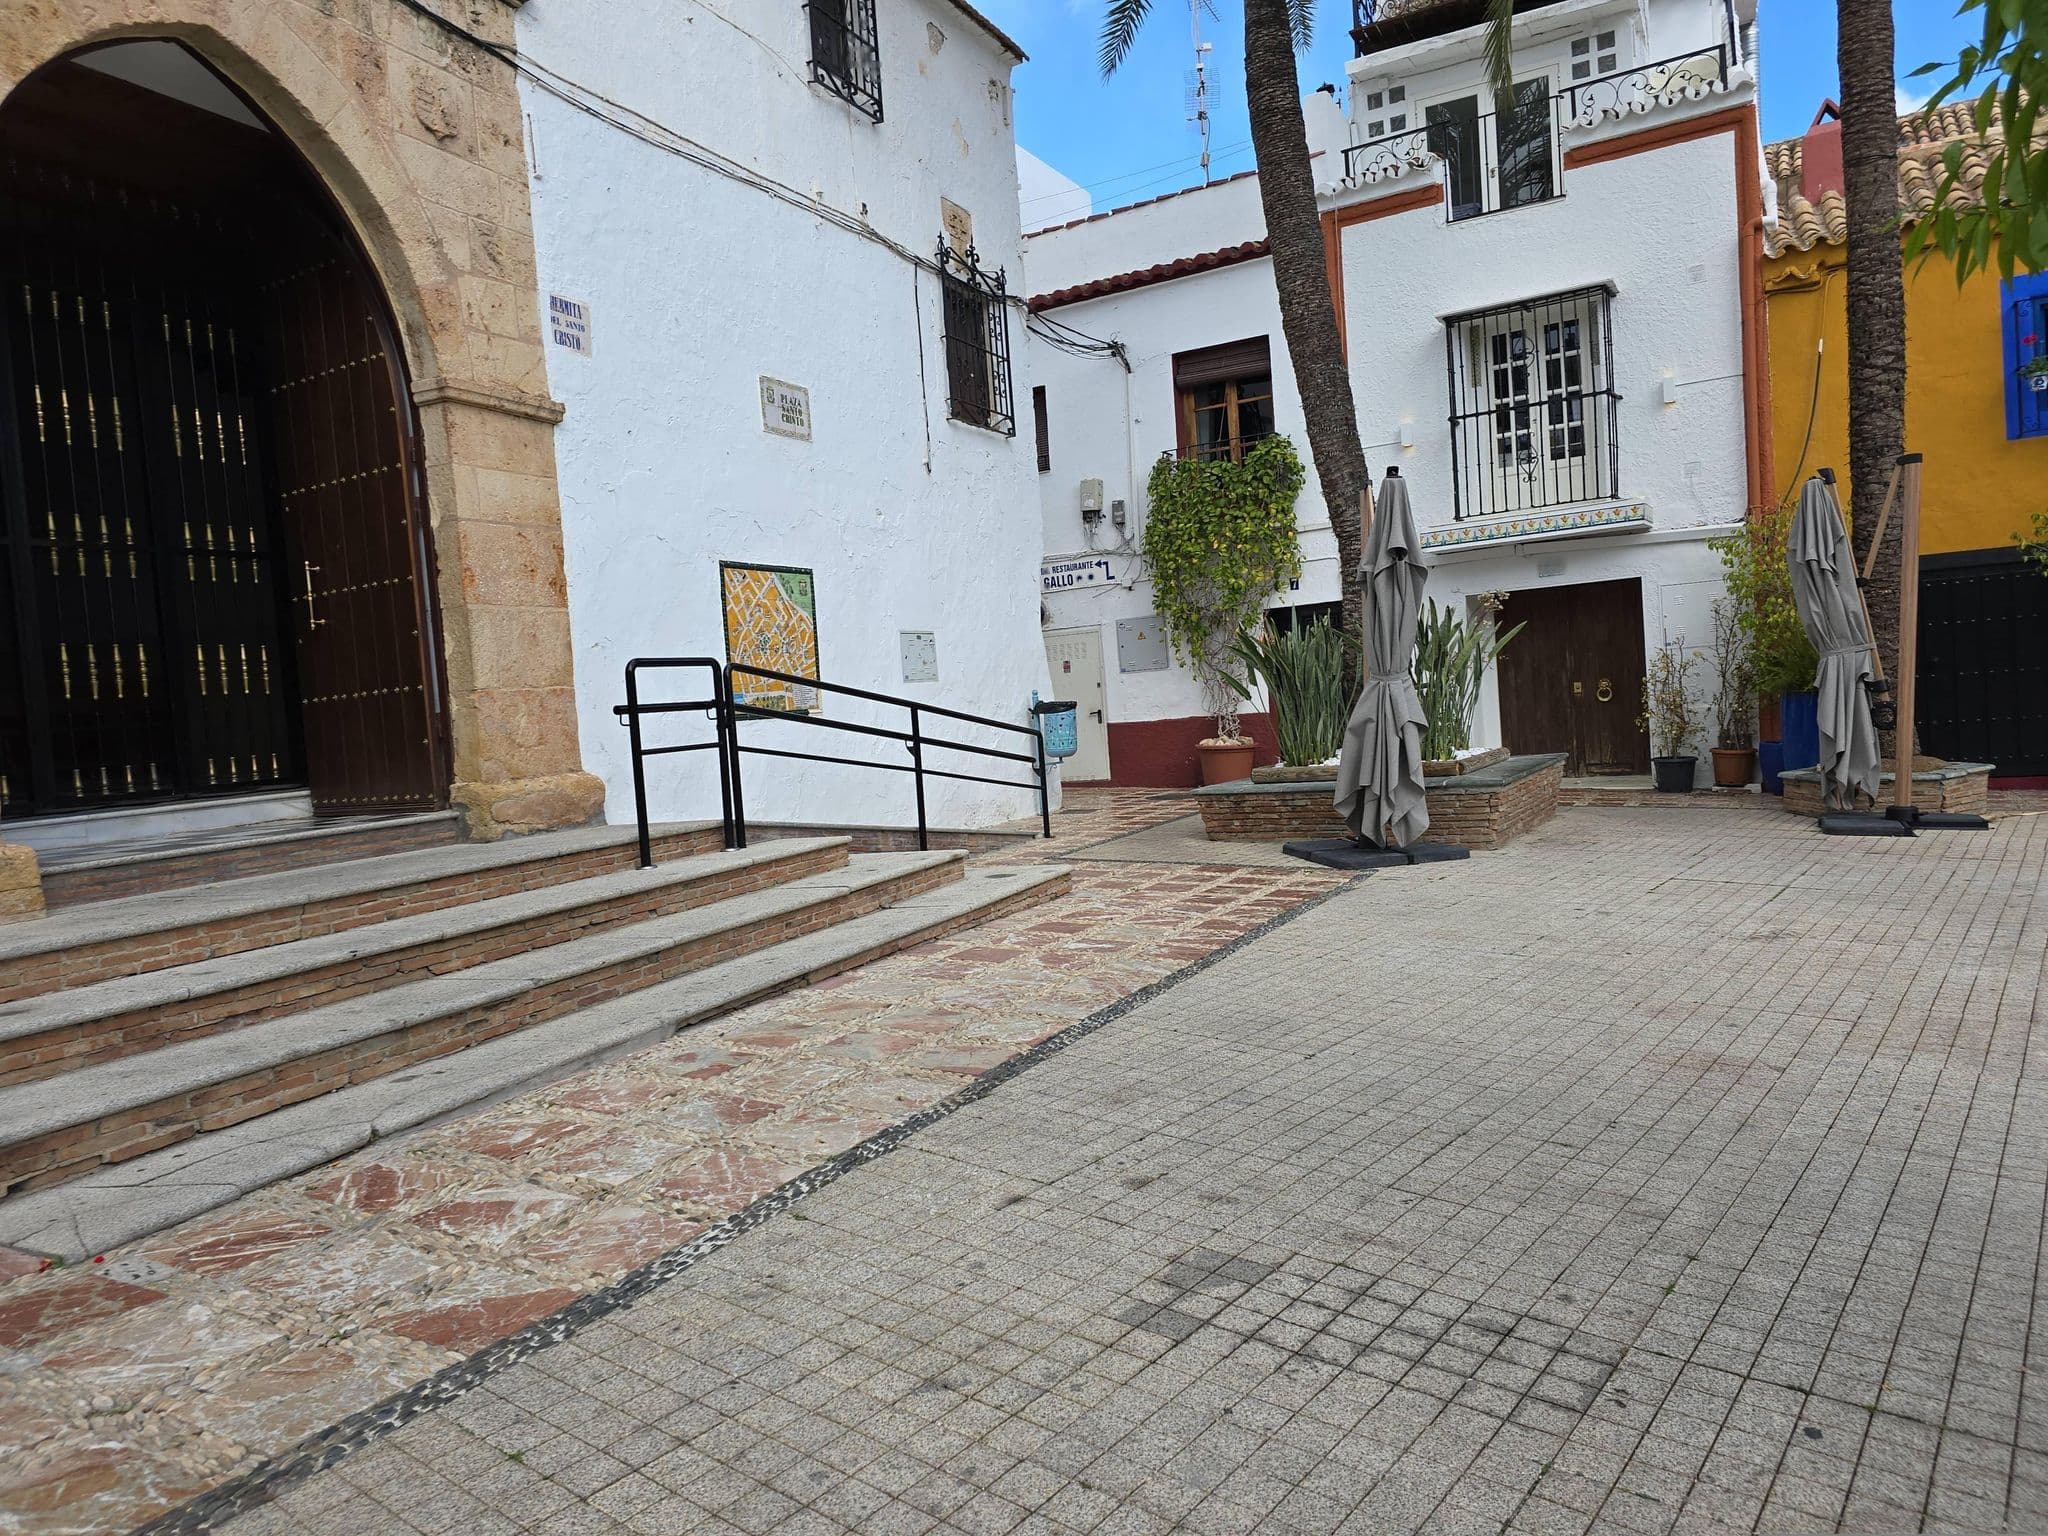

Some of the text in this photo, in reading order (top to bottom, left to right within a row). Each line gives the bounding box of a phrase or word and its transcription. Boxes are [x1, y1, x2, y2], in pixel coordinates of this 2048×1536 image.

[565, 320, 585, 332] SANTO
[554, 329, 581, 350] CRISTO
[780, 393, 802, 408] PLAZA
[781, 404, 802, 417] SANTO
[781, 413, 804, 427] CRISTO
[1052, 561, 1094, 574] RESTAURANTE
[1043, 574, 1074, 589] GALLO
